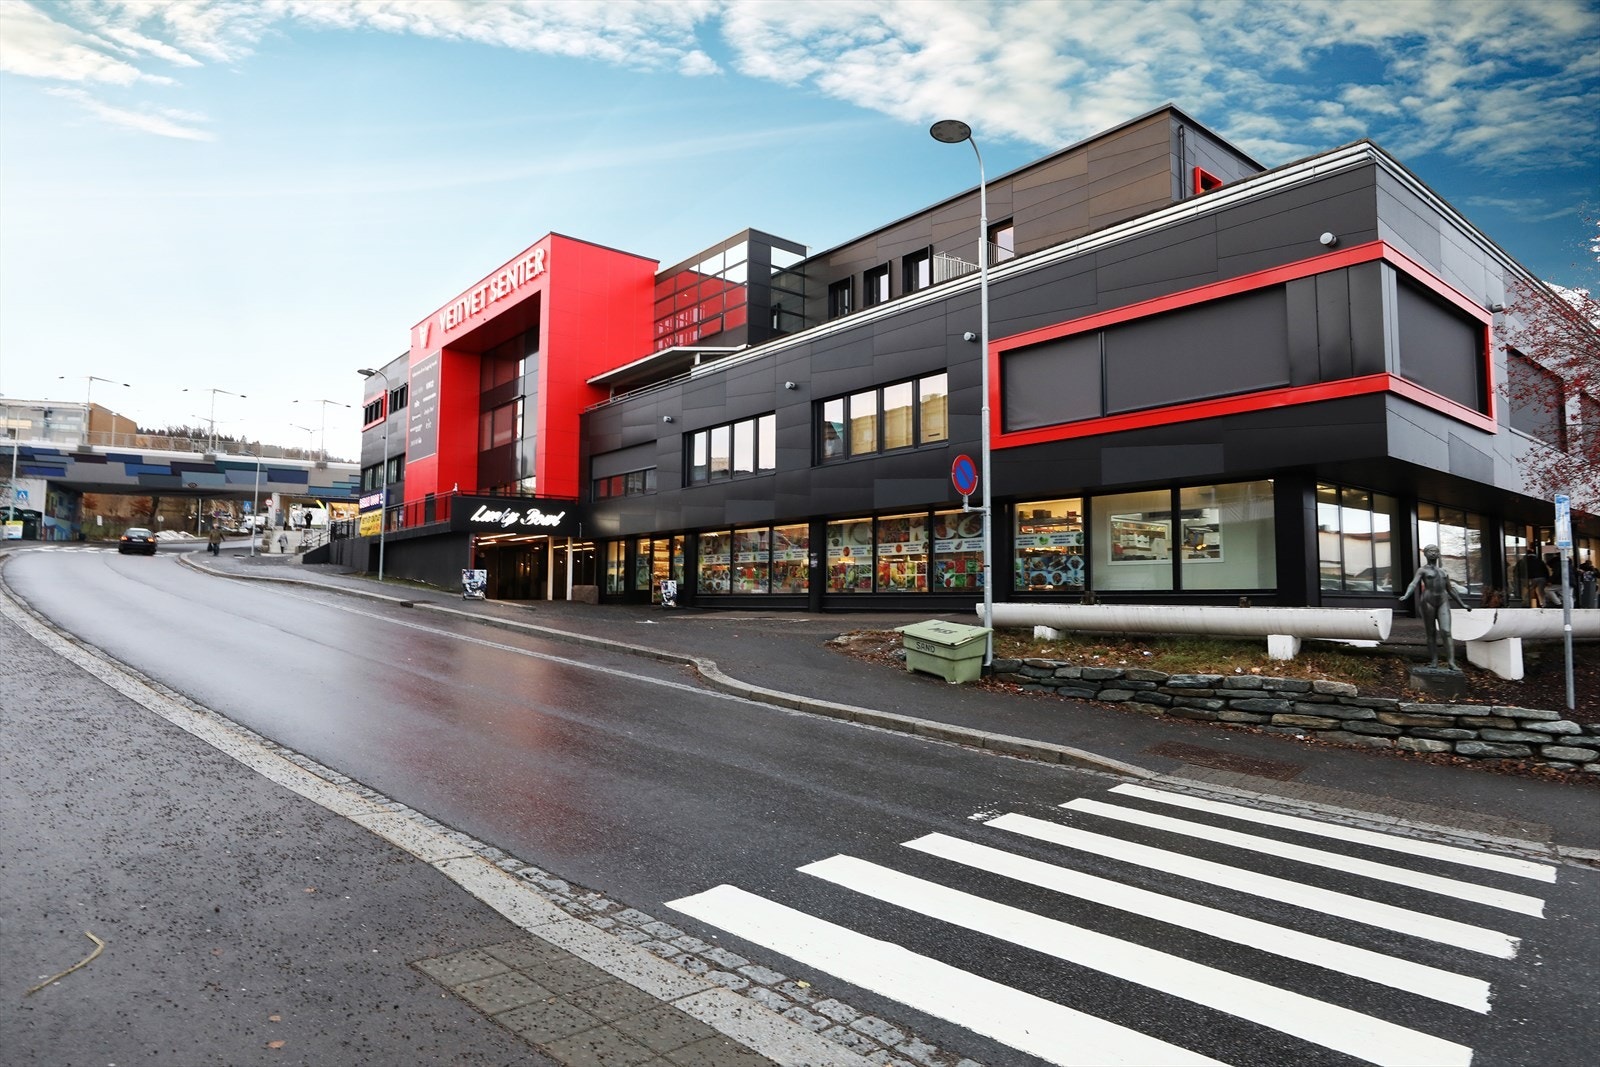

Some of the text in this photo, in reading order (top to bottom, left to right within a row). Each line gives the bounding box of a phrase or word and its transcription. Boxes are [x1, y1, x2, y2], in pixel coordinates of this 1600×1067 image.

[439, 248, 546, 332] VEITVET SENTER
[470, 504, 566, 528] Lucky Bowl
[916, 641, 936, 653] SAND
